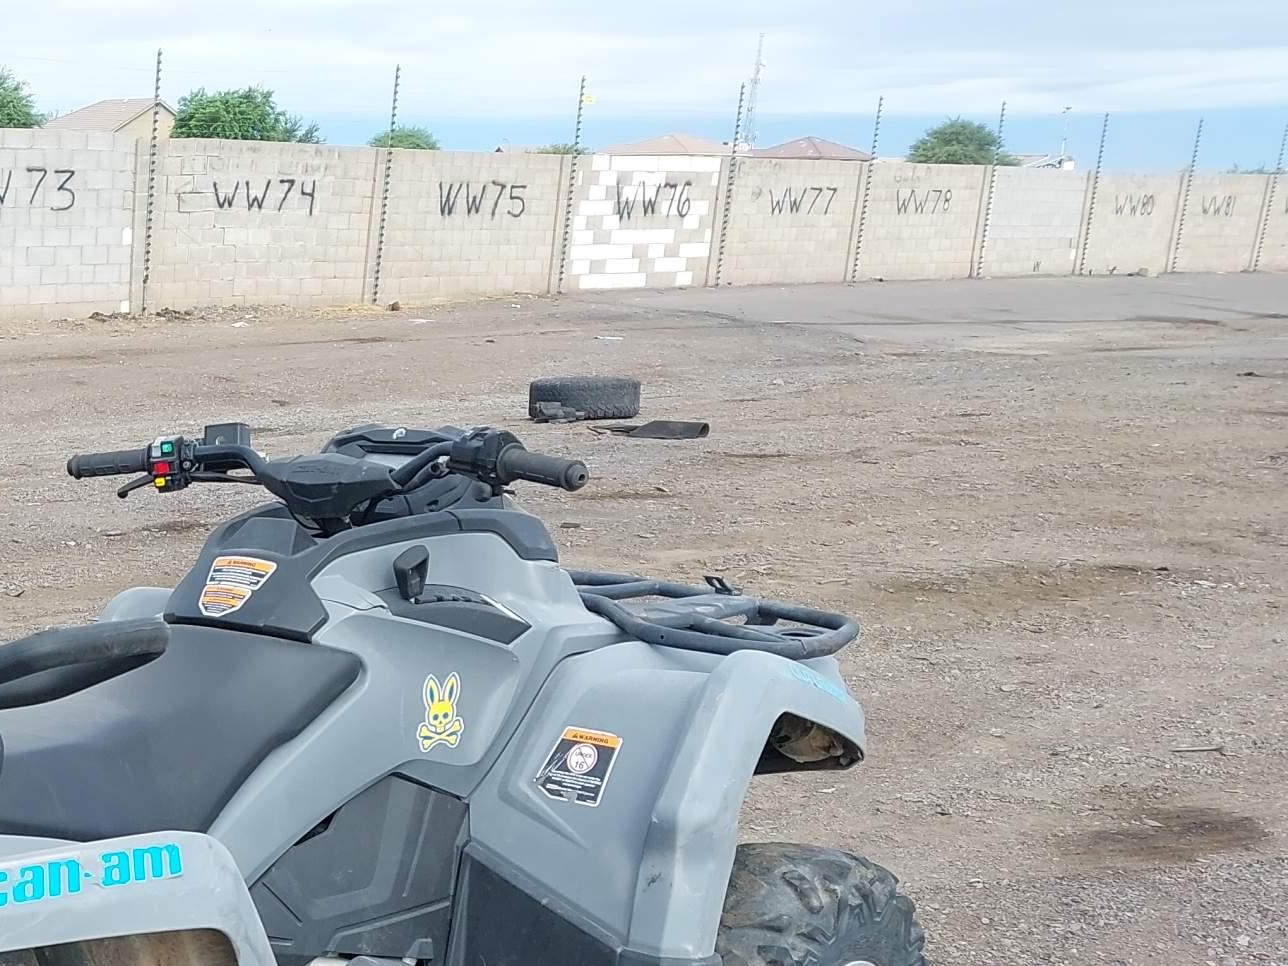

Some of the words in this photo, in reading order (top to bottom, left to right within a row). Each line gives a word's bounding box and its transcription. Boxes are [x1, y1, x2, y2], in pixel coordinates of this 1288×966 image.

[213, 179, 316, 216] WW74
[439, 180, 527, 220] WW75
[615, 179, 692, 223] WW76
[769, 187, 838, 215] WW77
[896, 189, 953, 215] WW78
[1114, 194, 1155, 216] WW80
[1201, 194, 1237, 217] WW81
[579, 735, 609, 744] WARNING
[575, 761, 585, 770] 16
